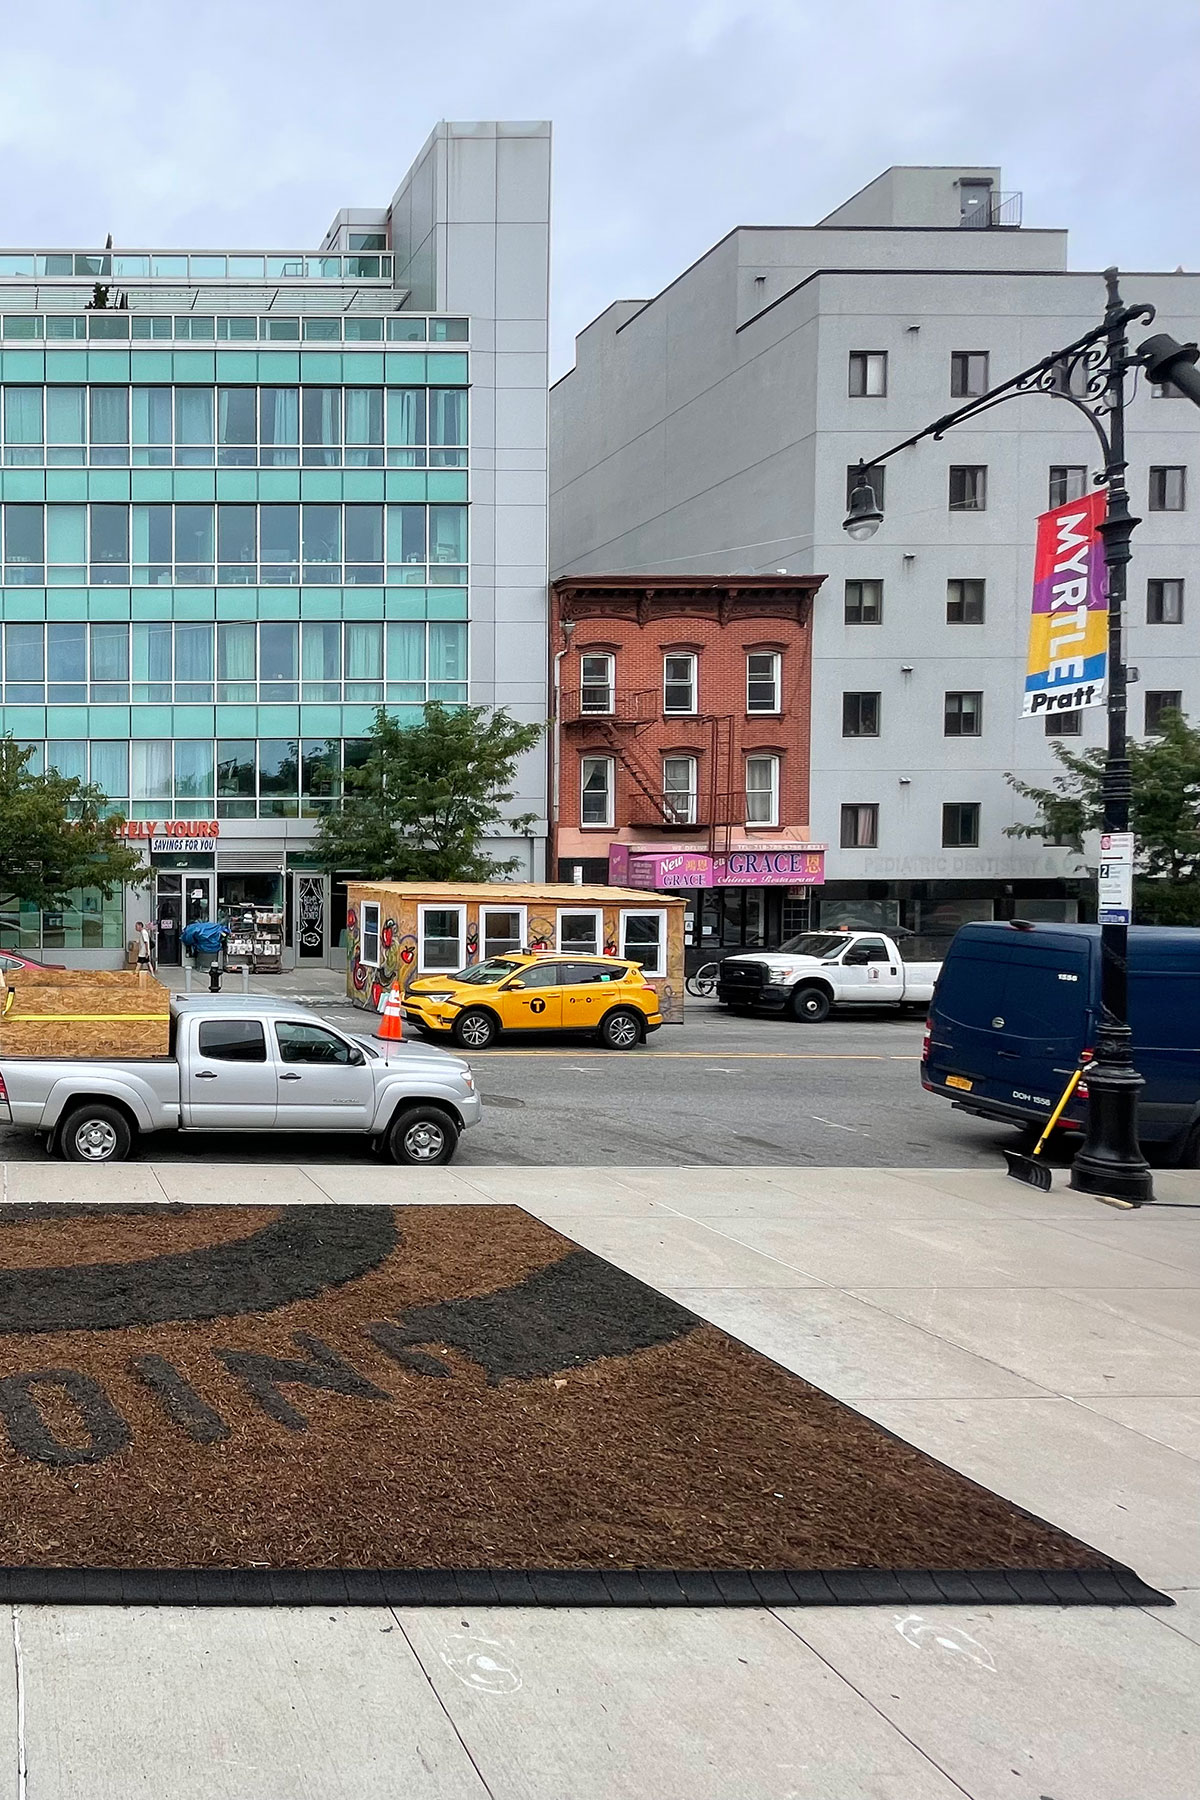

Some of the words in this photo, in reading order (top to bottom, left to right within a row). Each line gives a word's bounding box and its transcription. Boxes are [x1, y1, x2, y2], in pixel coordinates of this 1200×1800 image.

[1047, 512, 1089, 683] MYRTLE
[1030, 685, 1096, 713] Pratt
[165, 821, 220, 837] YOURS
[154, 839, 182, 851] SAVINGS
[185, 839, 198, 851] FOR
[200, 839, 214, 851] YOU
[660, 855, 684, 875] New
[728, 852, 802, 874] GRACE
[663, 874, 705, 887] GRACE
[761, 875, 816, 883] Restaurant
